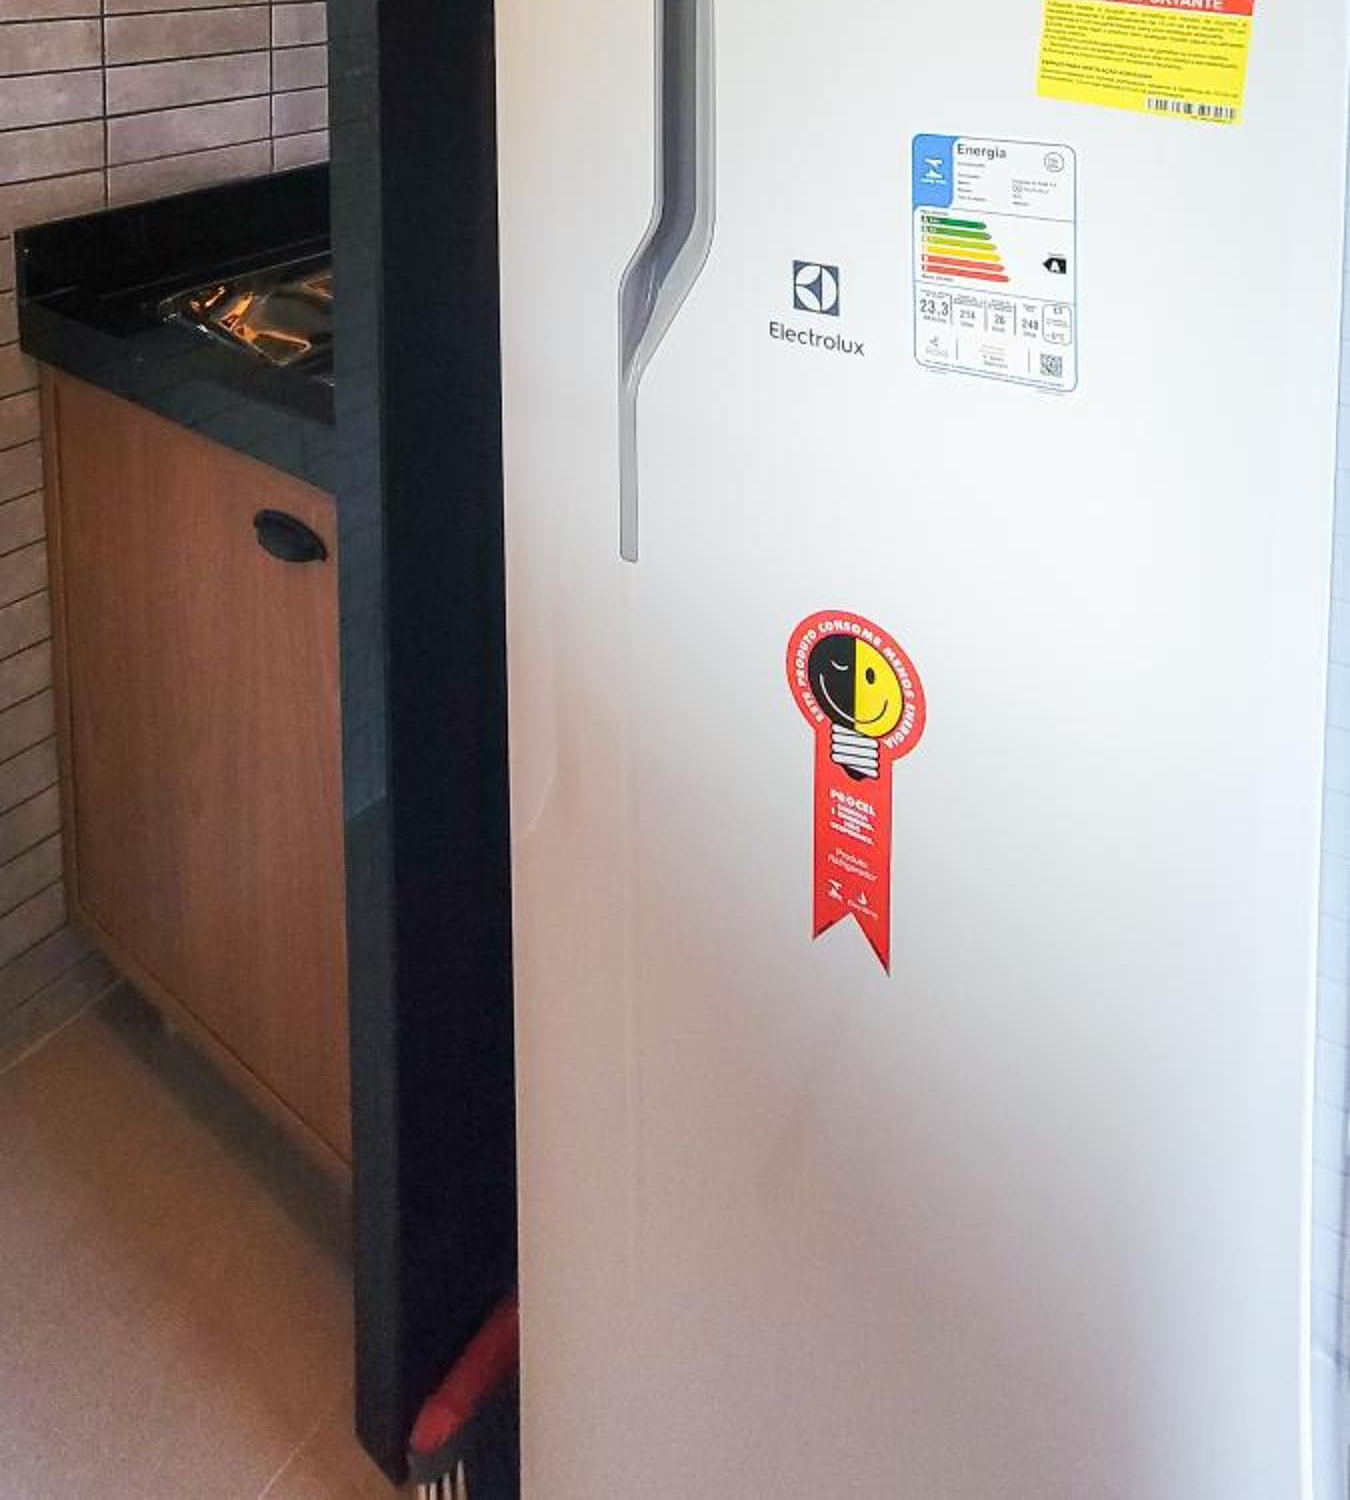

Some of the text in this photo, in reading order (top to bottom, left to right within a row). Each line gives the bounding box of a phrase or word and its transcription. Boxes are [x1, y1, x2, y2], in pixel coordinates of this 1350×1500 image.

[957, 143, 1007, 160] Energia
[769, 321, 865, 357] Electrolux
[818, 619, 881, 646] CONSOME
[795, 629, 817, 688] PRODUTO
[883, 646, 916, 700] MENOS
[884, 702, 916, 748] ENERGIA
